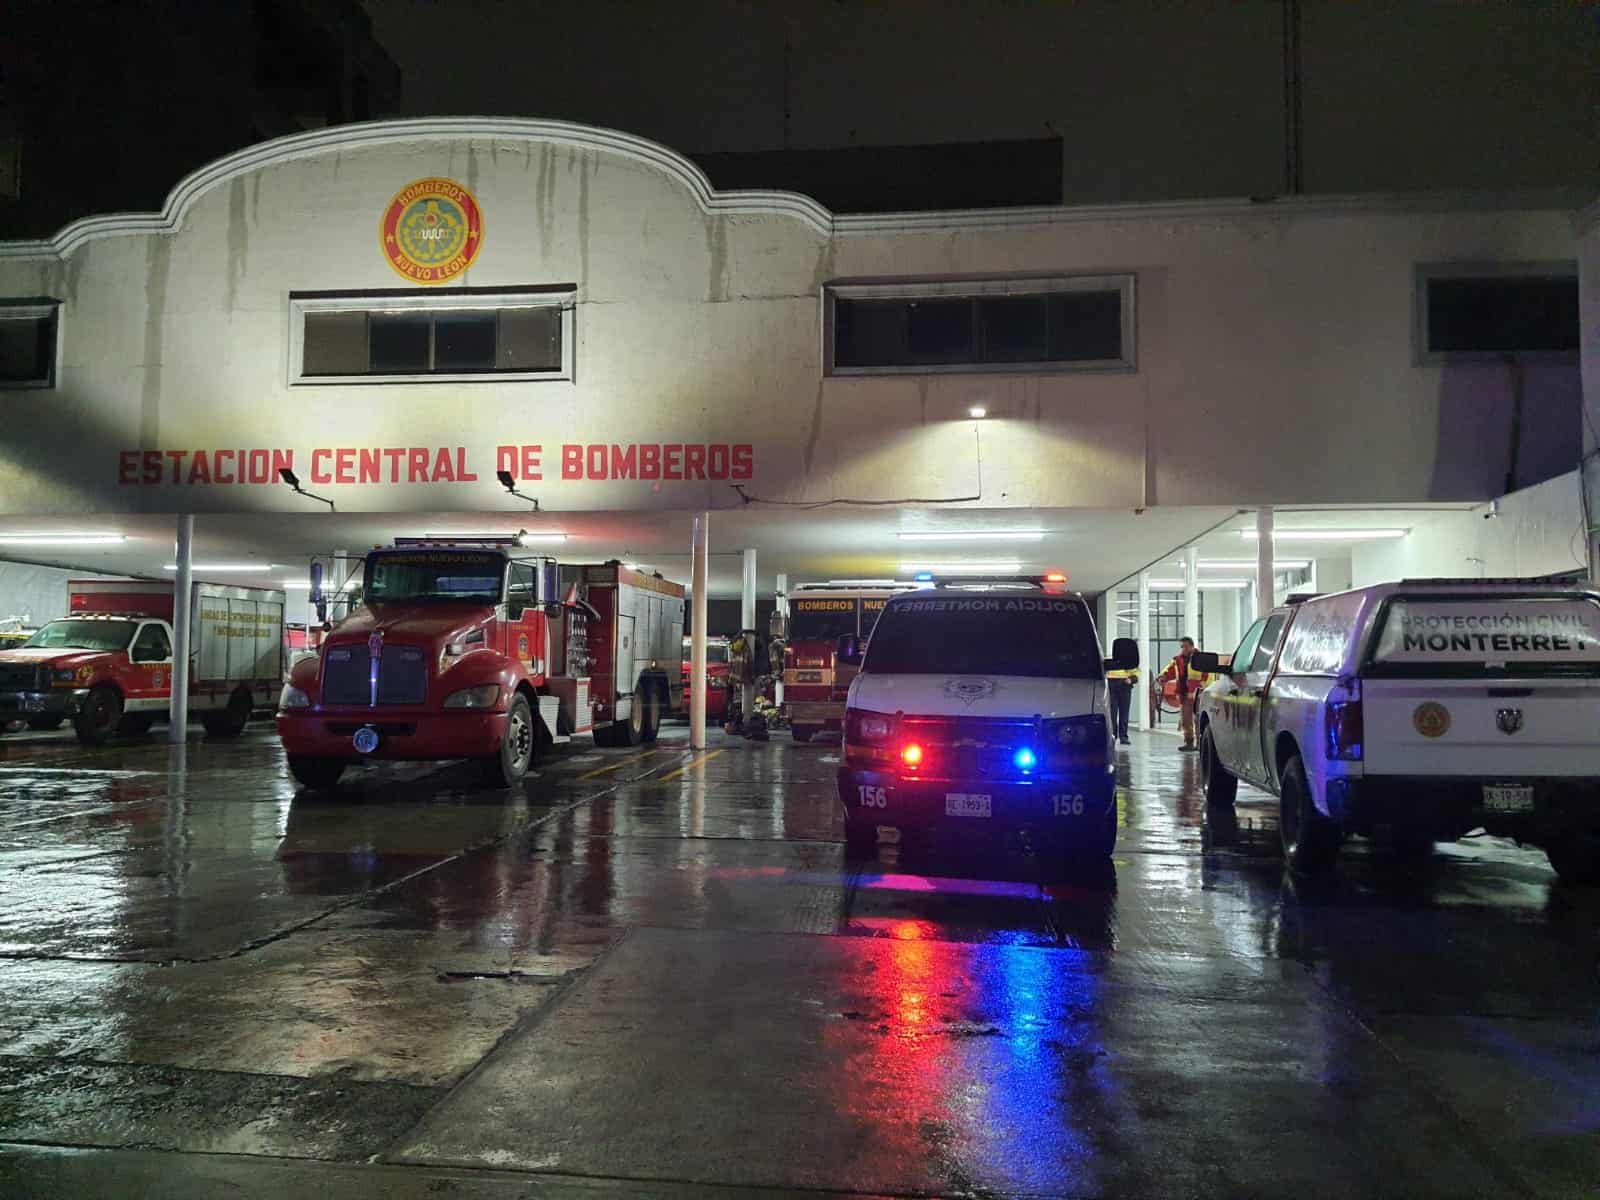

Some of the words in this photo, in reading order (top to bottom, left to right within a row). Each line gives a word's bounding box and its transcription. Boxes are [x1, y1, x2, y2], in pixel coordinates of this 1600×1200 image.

[393, 255, 432, 279] NUEVO
[120, 449, 293, 484] ESTACION
[311, 447, 477, 483] CENTRAL
[496, 445, 542, 480] DE
[562, 444, 753, 480] BOMBEROS
[797, 600, 853, 610] BOMBEROS
[1401, 612, 1528, 629] PROTECCIÓN
[857, 785, 887, 810] 156
[1052, 793, 1084, 815] 156
